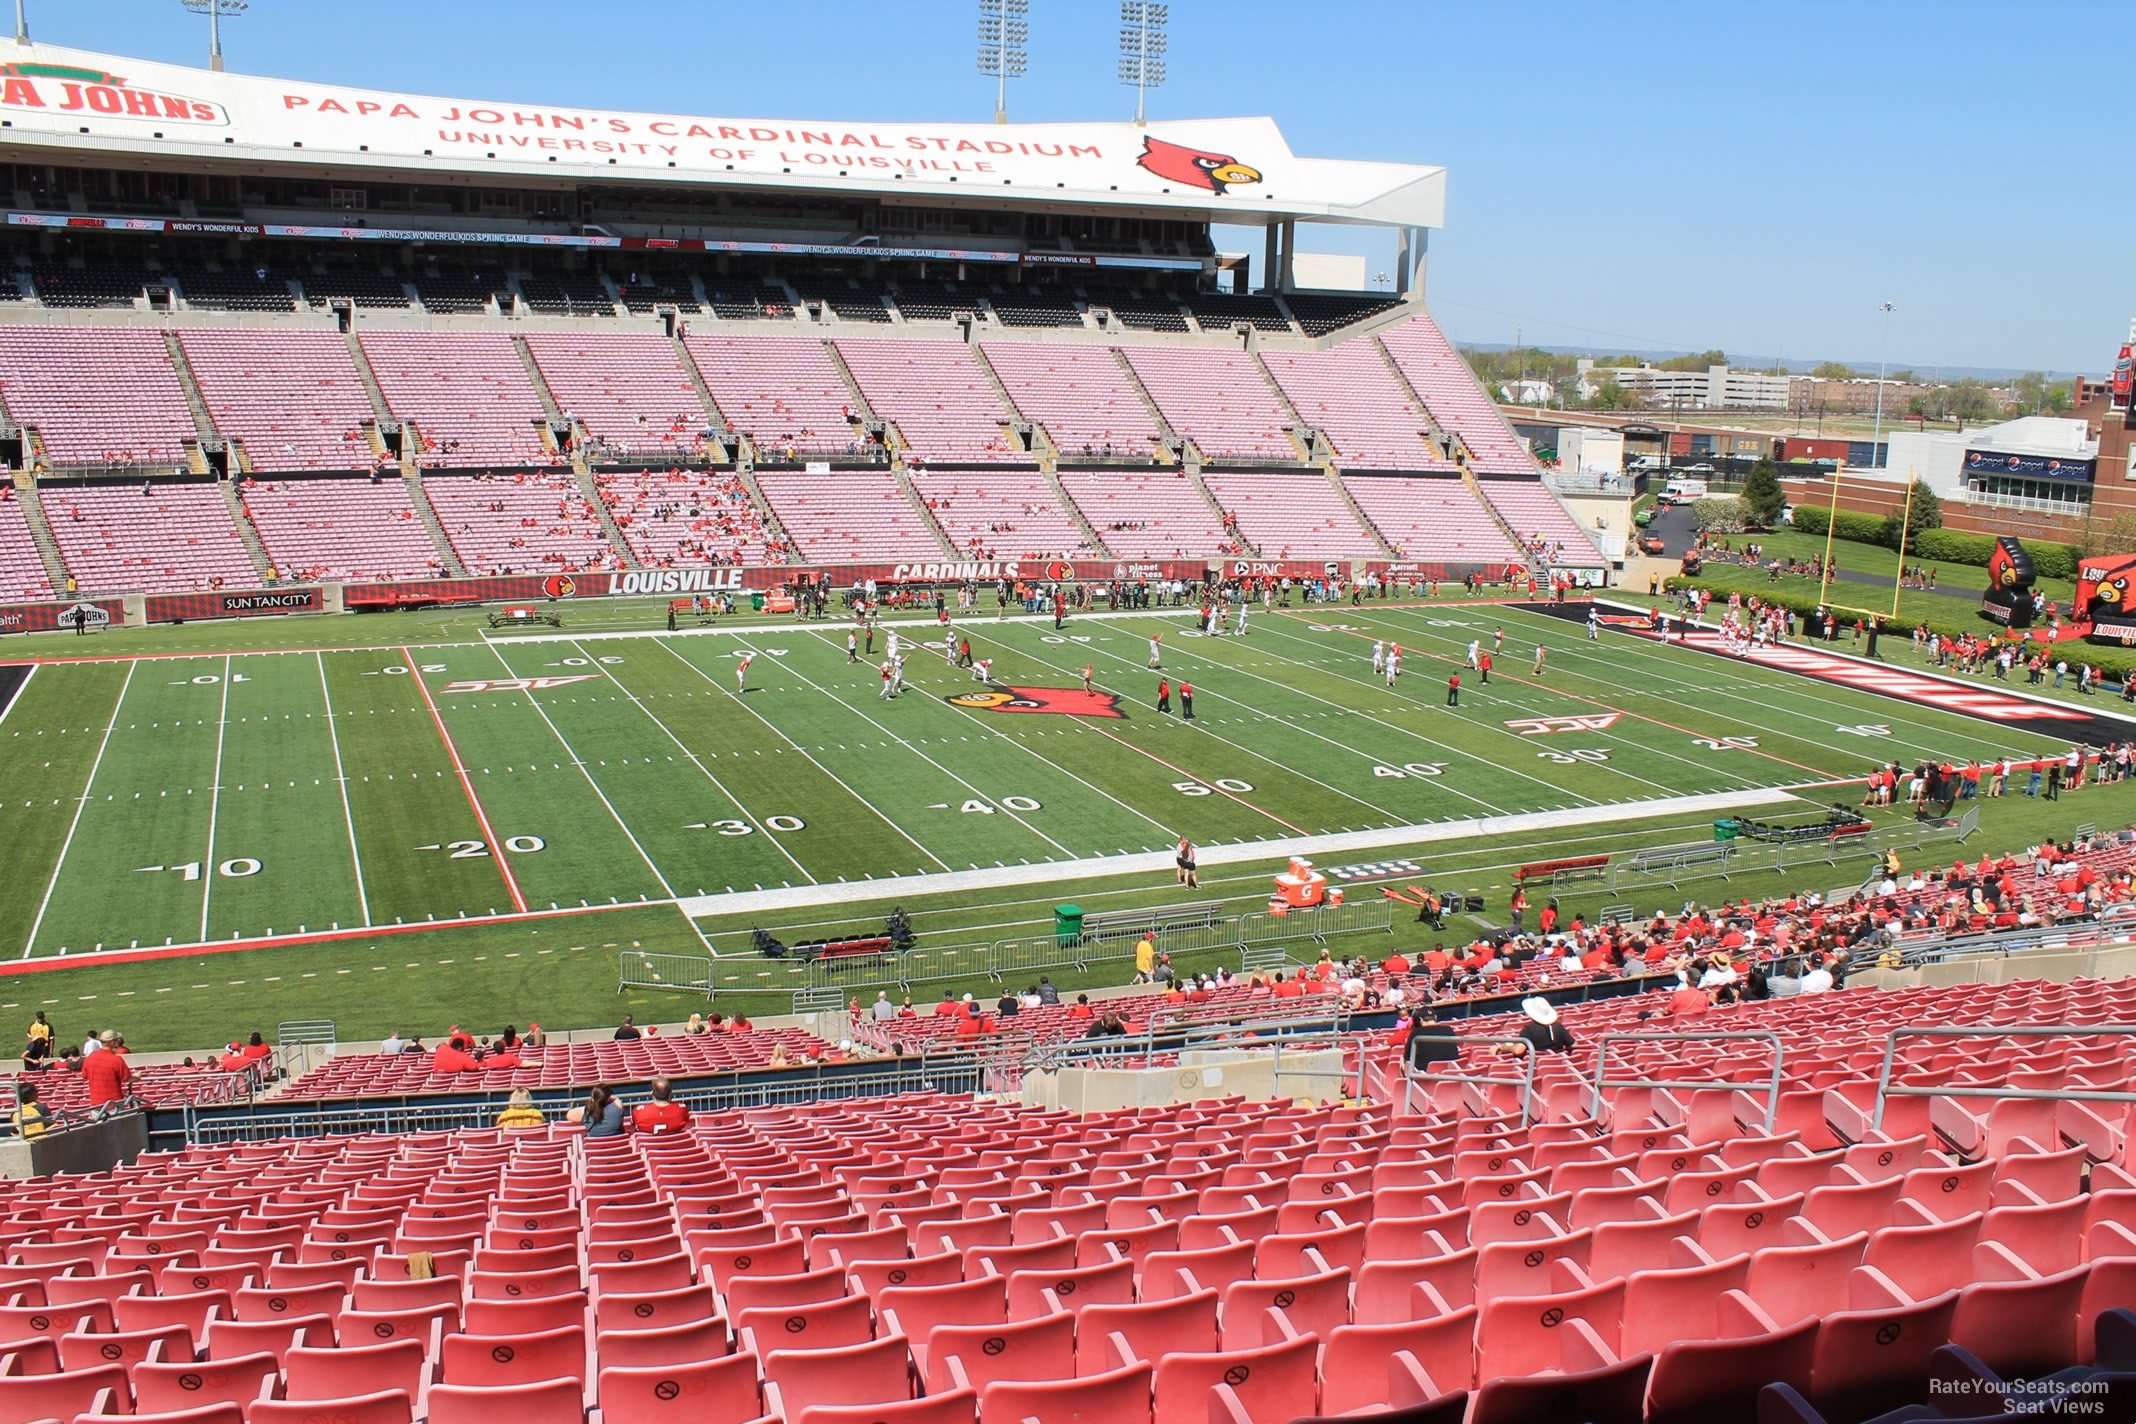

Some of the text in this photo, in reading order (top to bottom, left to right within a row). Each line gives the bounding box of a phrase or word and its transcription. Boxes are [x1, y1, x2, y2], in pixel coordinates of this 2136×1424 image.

[283, 95, 1103, 159] PAPA JOHN'S CARDINAL STADIUM
[438, 130, 996, 173] UNIVERSITY OF LOUISVILLE
[172, 222, 260, 234] WENDY'S WONDERFUL KIDS
[377, 230, 529, 243] WENDY'S WONDERFUL KIDS SPRING GAME
[802, 245, 832, 254] WENDY'S
[889, 248, 915, 257] SPRING
[916, 249, 936, 258] GAME
[1981, 457, 2004, 467] pepsi
[2020, 461, 2044, 471] pepsi
[2060, 465, 2086, 476] pepsi
[1983, 520, 2044, 537] Football Complex
[1128, 562, 1159, 573] planet
[1131, 569, 1163, 578] fitness
[1252, 562, 1286, 576] PNC
[1387, 563, 1419, 572] Marriott
[609, 562, 1019, 595] LOUISVILLE CARDINALS
[226, 594, 311, 609] SUN TAN CITY
[0, 614, 20, 626] alth
[1040, 634, 1092, 645] 40
[731, 648, 790, 658] 40
[562, 655, 625, 666] 30
[383, 664, 448, 675] 20
[191, 674, 252, 685] 10
[1504, 712, 1624, 736] ACC
[1836, 724, 1894, 737] 10
[1691, 736, 1761, 751] 20
[1537, 748, 1609, 765] 30
[1373, 761, 1445, 780] 40
[1171, 777, 1256, 797] 50
[960, 795, 1043, 815] 40
[711, 815, 806, 837] 30
[447, 835, 547, 859] 20
[170, 857, 263, 882] 10
[1302, 884, 1313, 898] G
